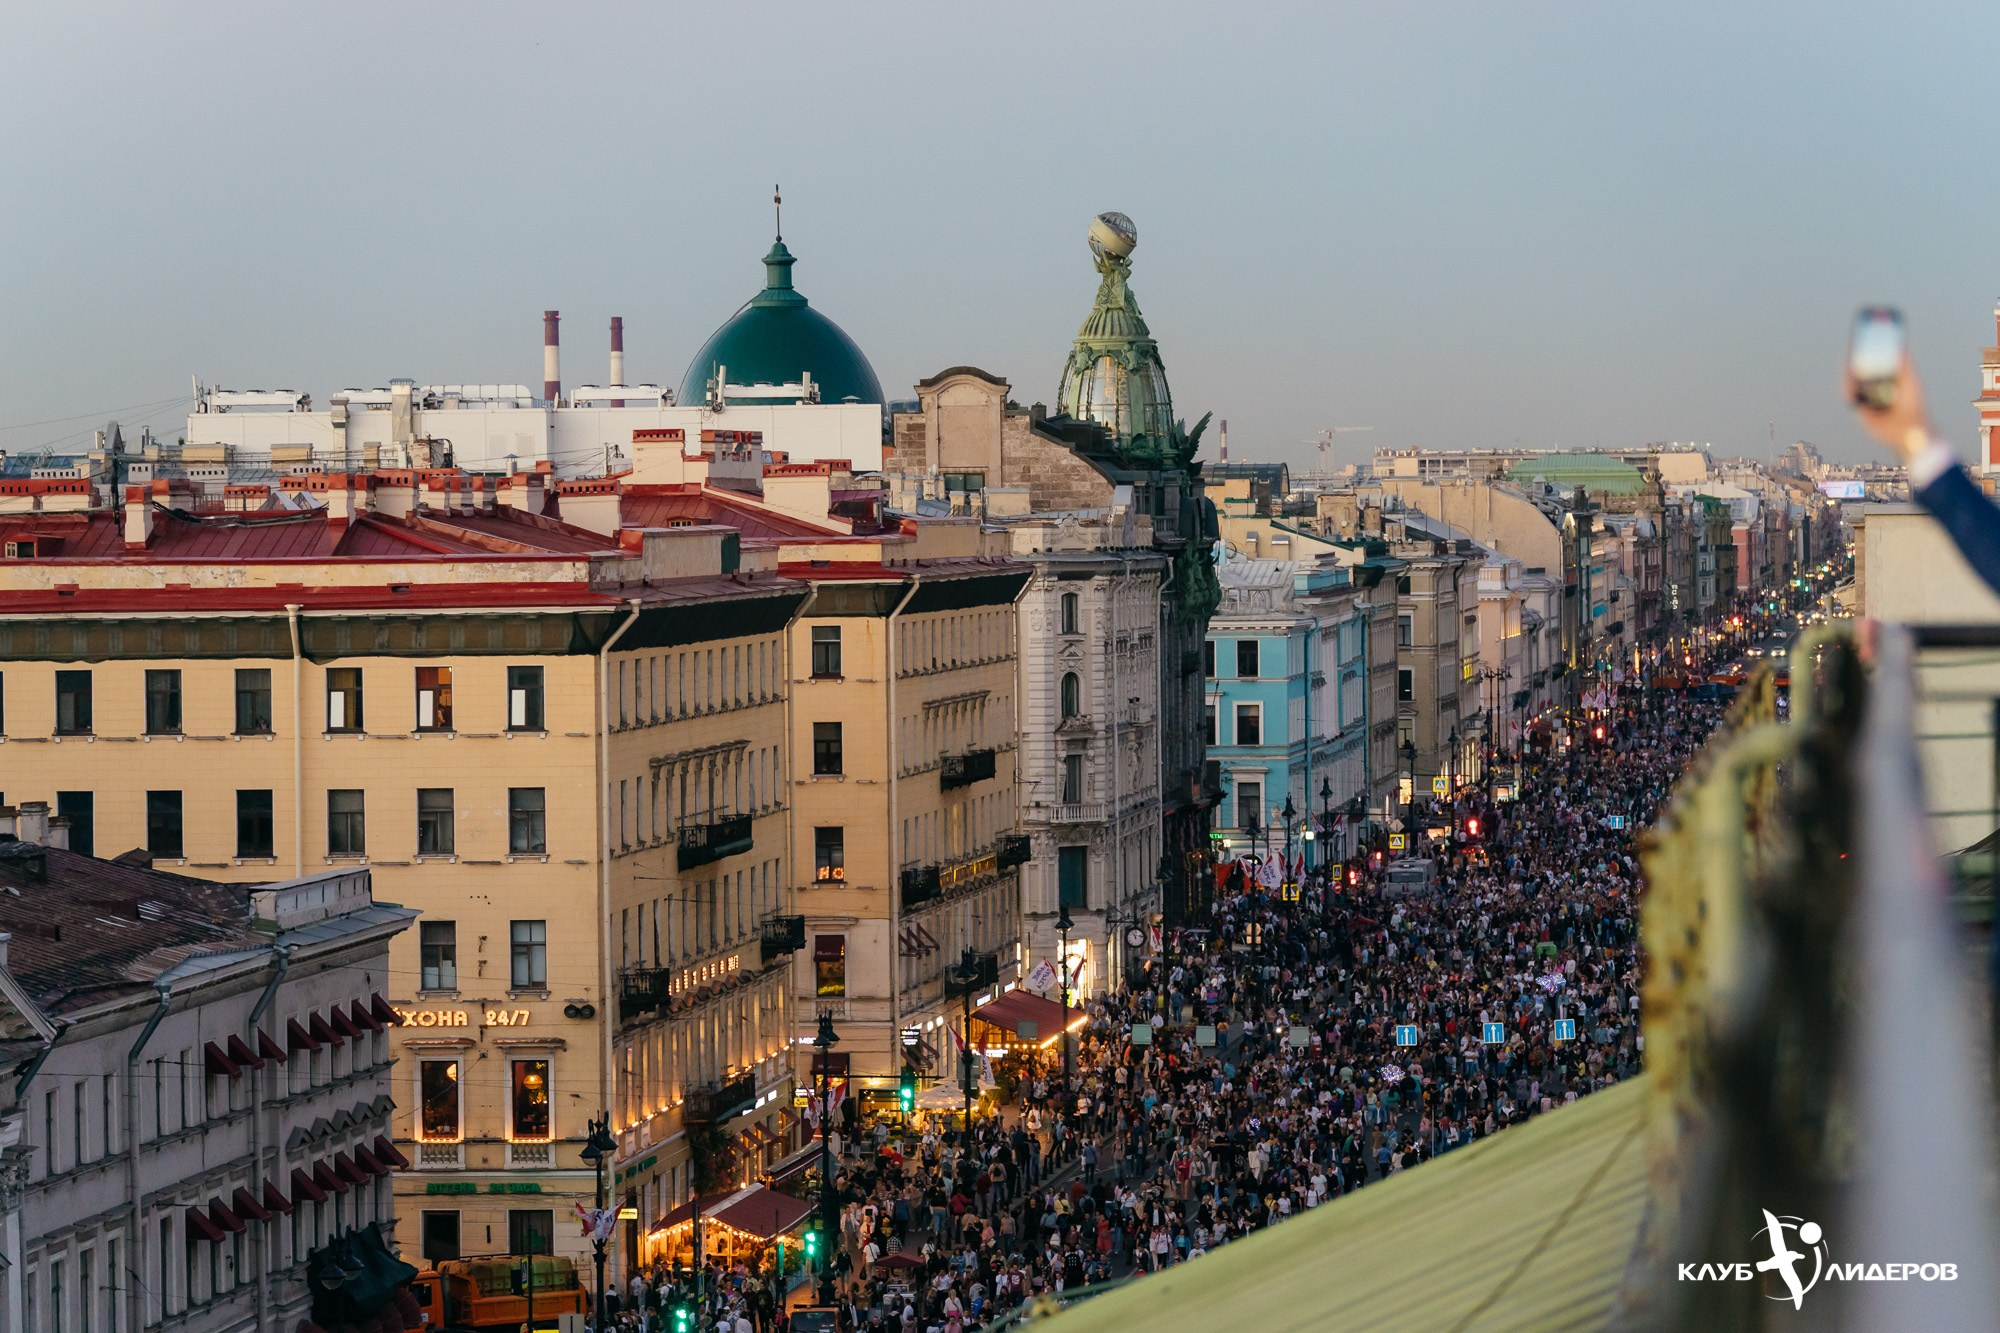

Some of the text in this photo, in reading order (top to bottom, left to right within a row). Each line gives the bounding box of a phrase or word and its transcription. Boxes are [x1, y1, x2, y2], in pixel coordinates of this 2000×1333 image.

[485, 1009, 530, 1026] 24/7
[426, 1182, 477, 1194] АПТЕКА
[507, 1182, 541, 1193] ЧАСА
